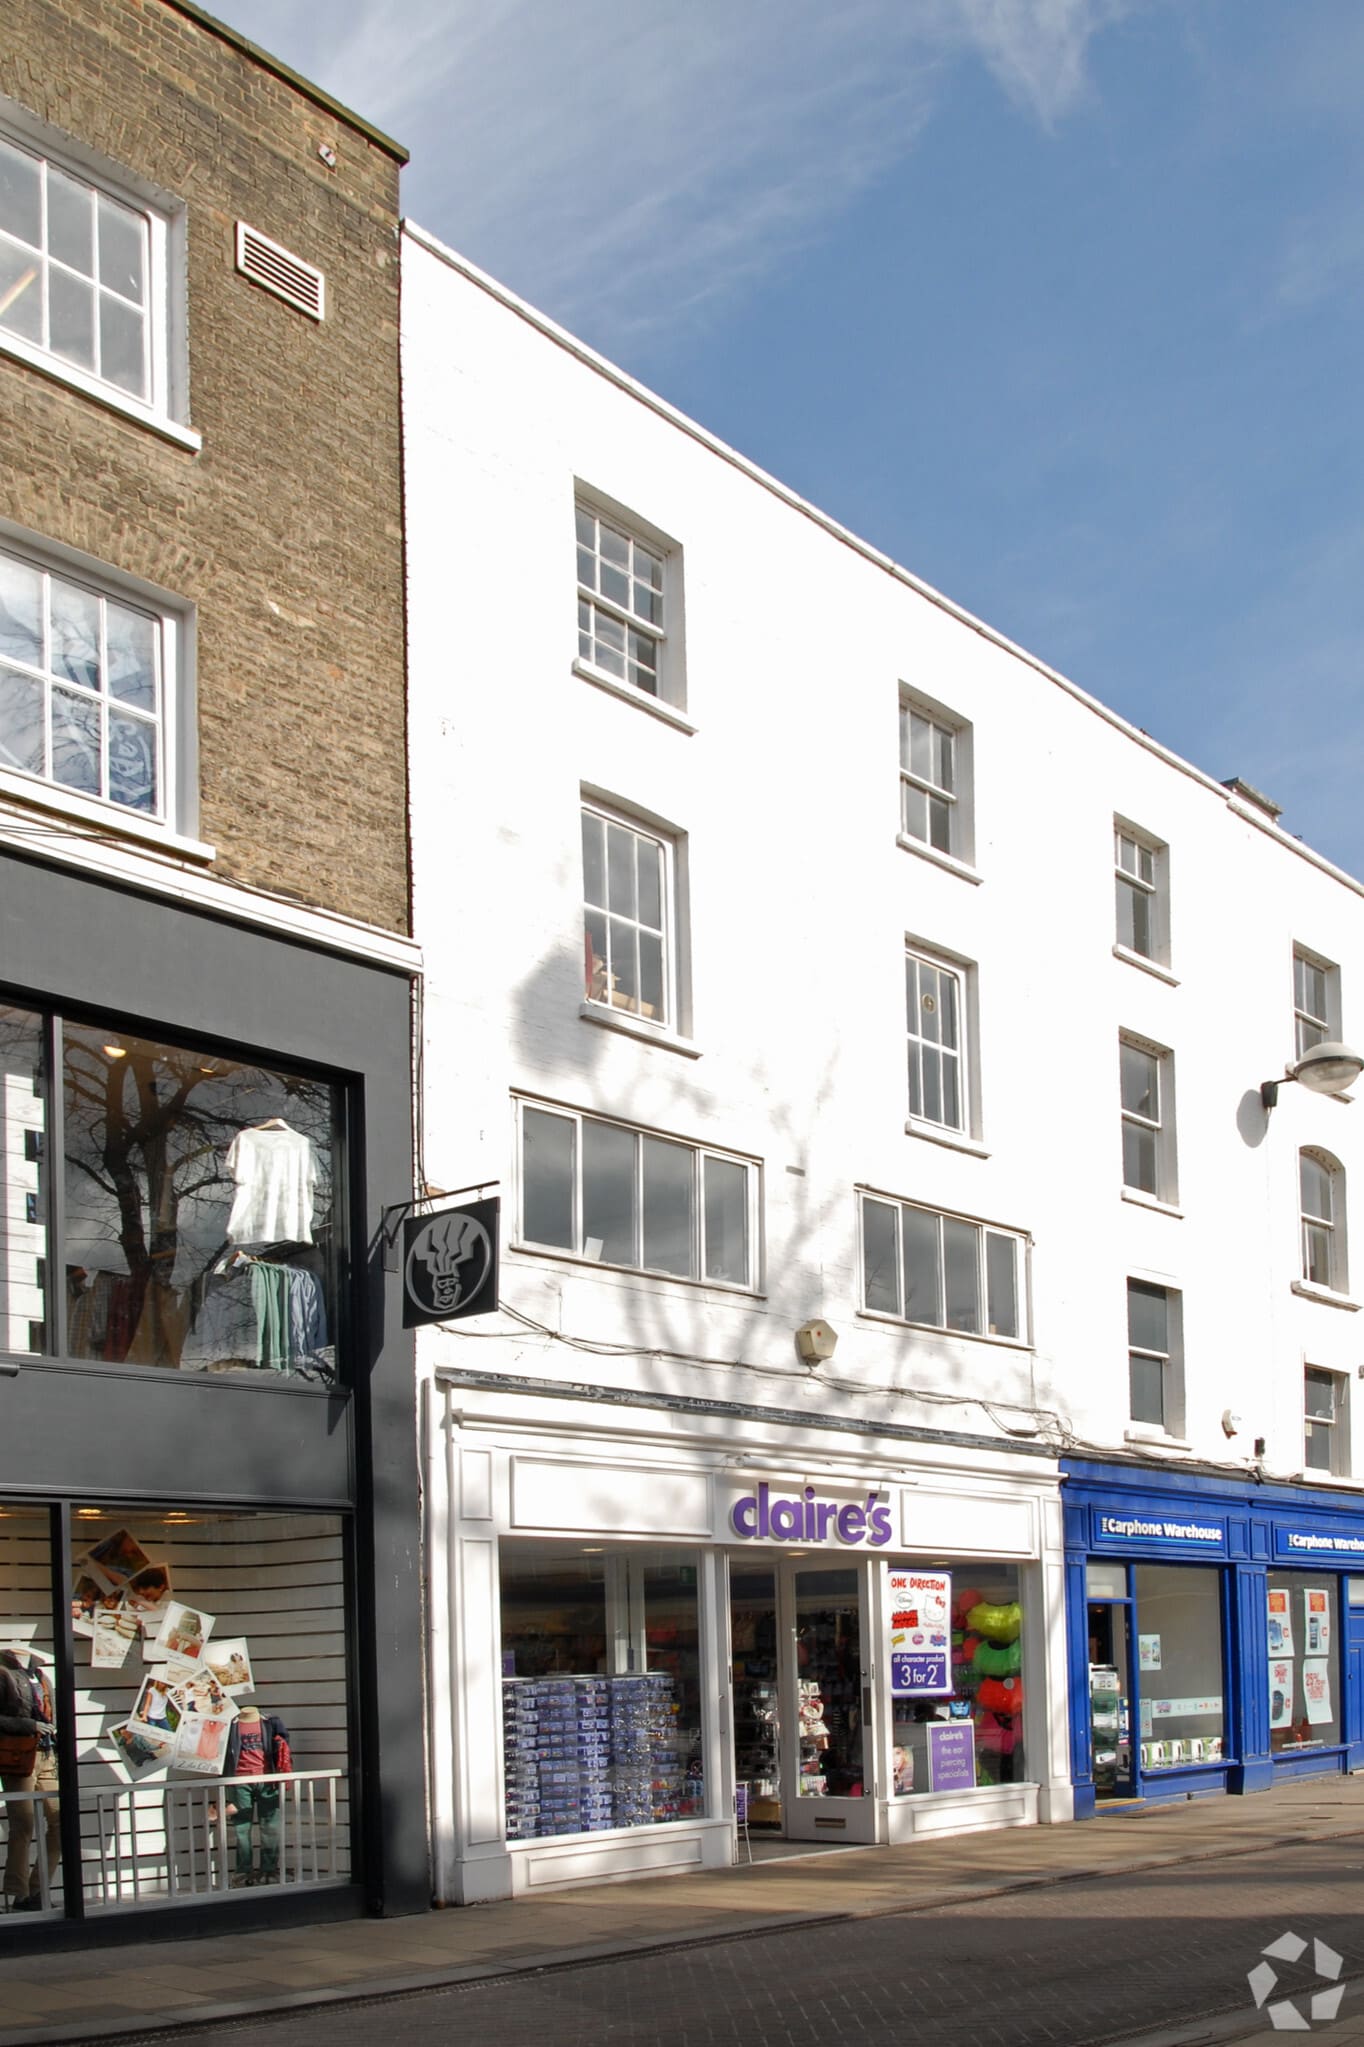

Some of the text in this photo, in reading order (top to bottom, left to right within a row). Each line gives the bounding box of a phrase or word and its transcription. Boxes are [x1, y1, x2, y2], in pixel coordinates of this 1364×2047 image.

[733, 1482, 892, 1545] claire's
[1108, 1518, 1162, 1536] Carphone
[1163, 1523, 1222, 1541] Warehouse
[1293, 1534, 1333, 1549] Carphone
[891, 1577, 945, 1591] ONE DIRECTION
[901, 1665, 911, 1686] 3
[913, 1669, 927, 1683] for
